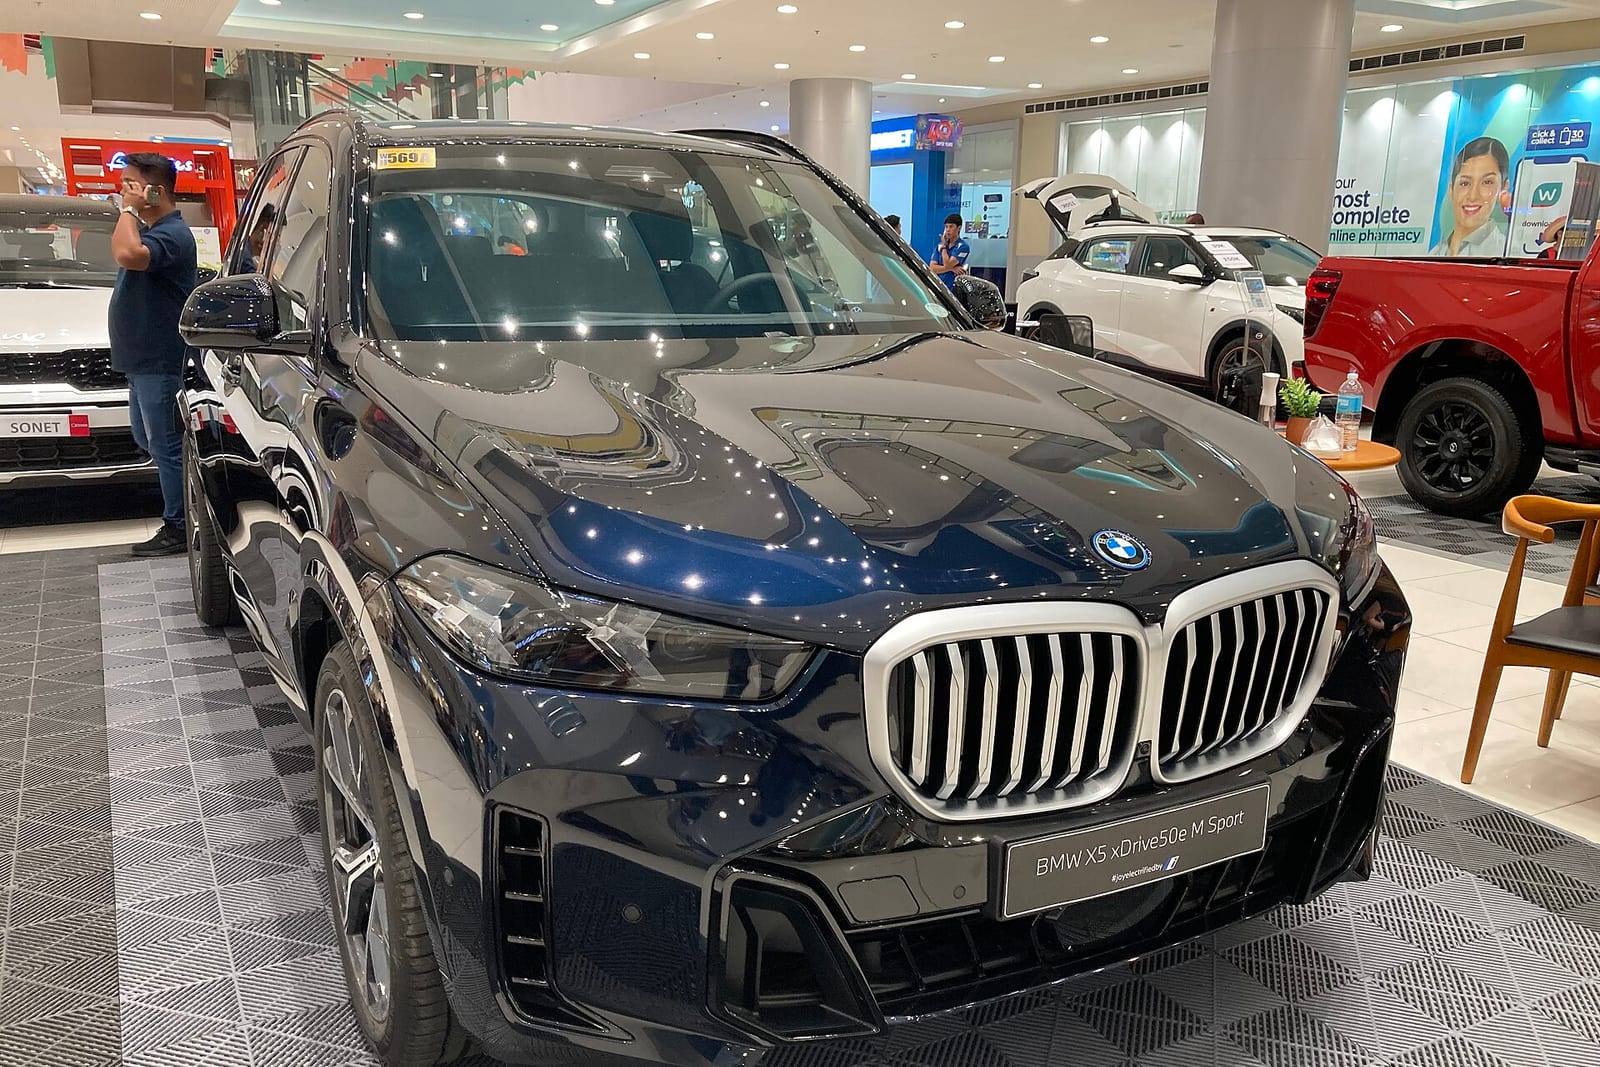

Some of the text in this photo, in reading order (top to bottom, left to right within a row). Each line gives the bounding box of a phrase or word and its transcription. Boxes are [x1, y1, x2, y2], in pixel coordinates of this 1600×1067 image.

[1532, 129, 1549, 138] click
[1571, 129, 1584, 138] 30
[1530, 137, 1555, 145] collect
[1335, 178, 1357, 189] our
[1332, 205, 1411, 228] omplete
[1521, 220, 1552, 228] downlo
[1329, 228, 1421, 244] nline pharmacy
[10, 422, 61, 433] SONET
[1036, 809, 1245, 877] BMW X5 xDrive50e M Sport
[1111, 864, 1163, 883] #joyelectrifiedby
